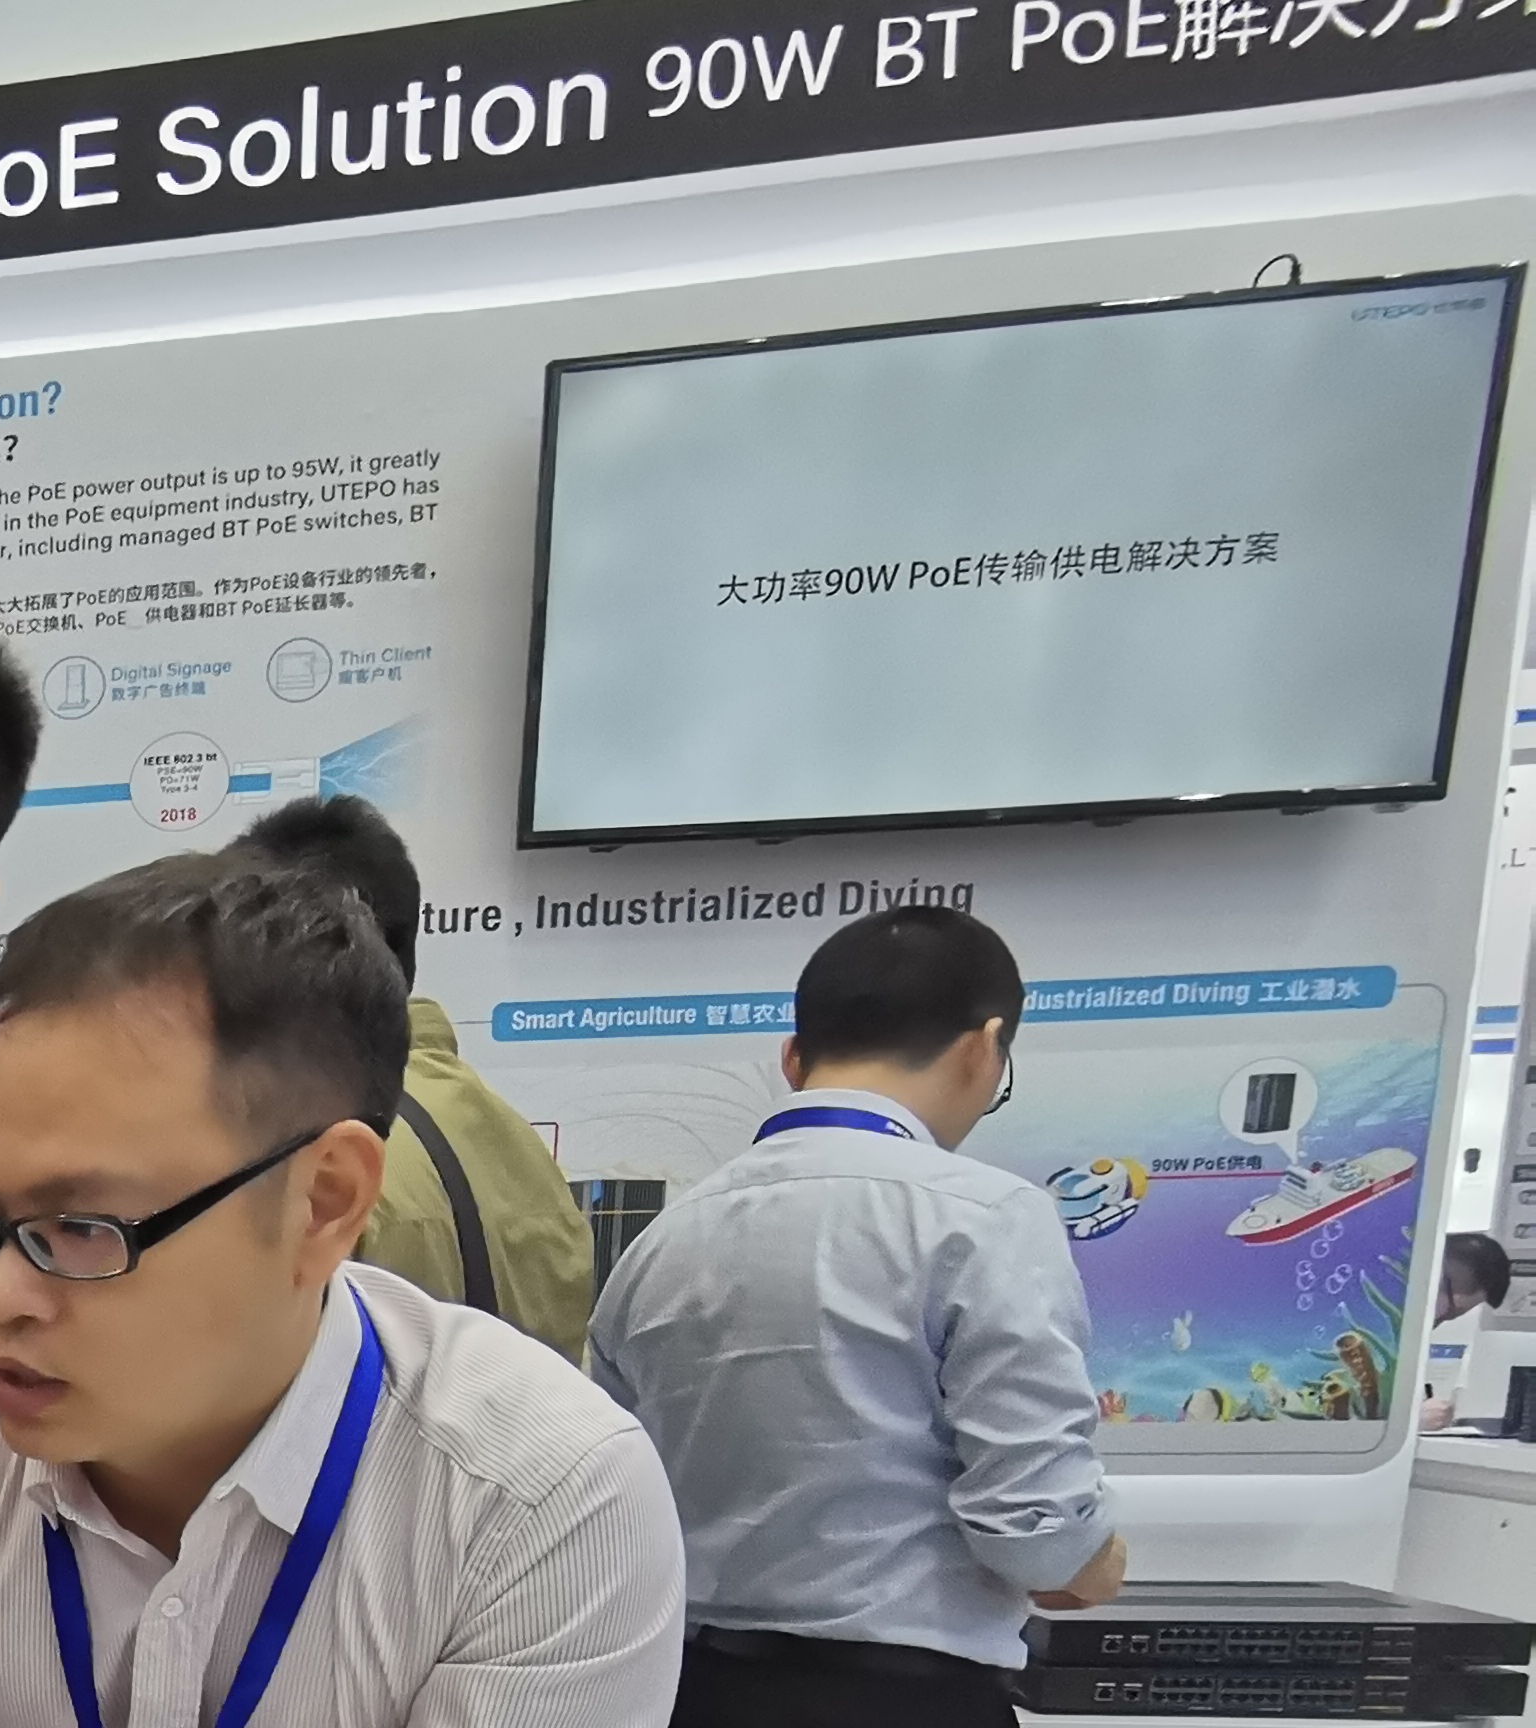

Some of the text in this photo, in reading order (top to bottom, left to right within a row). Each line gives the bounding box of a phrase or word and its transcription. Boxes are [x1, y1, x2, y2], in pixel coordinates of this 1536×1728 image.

[645, 6, 979, 119] 90W BT
[154, 64, 608, 199] Solution
[3, 513, 22, 532] in
[26, 510, 61, 531] the
[65, 505, 106, 527] PoE
[109, 494, 220, 524] equipment
[224, 489, 316, 519] industry,
[320, 479, 397, 503] UTEPO
[401, 476, 441, 496] has
[26, 481, 68, 505] PoE
[72, 476, 135, 505] power
[139, 468, 207, 498] output
[211, 466, 229, 486] is
[233, 465, 261, 490] up
[265, 463, 287, 482] to
[291, 457, 345, 482] 95W,
[349, 456, 364, 476] it
[367, 449, 441, 477] greatly
[17, 530, 113, 560] including
[118, 523, 216, 553] managed
[220, 518, 251, 539] BT
[255, 515, 297, 536] PoE
[303, 506, 405, 534] switches,
[408, 502, 439, 524] BT
[716, 530, 1281, 609] 大功率90W PoE传输供电解决方案
[111, 660, 233, 684] Digital Signage
[340, 645, 433, 667] Thin Client
[143, 755, 171, 767] IEEE
[160, 806, 197, 823] 2018
[423, 896, 503, 936] ture
[536, 882, 826, 931] Industrialized
[838, 876, 975, 917] Diving
[511, 1009, 576, 1033] Smart
[579, 1004, 698, 1032] Agriculture
[1024, 985, 1166, 1013] dustrialized
[1172, 981, 1251, 1009] Diving
